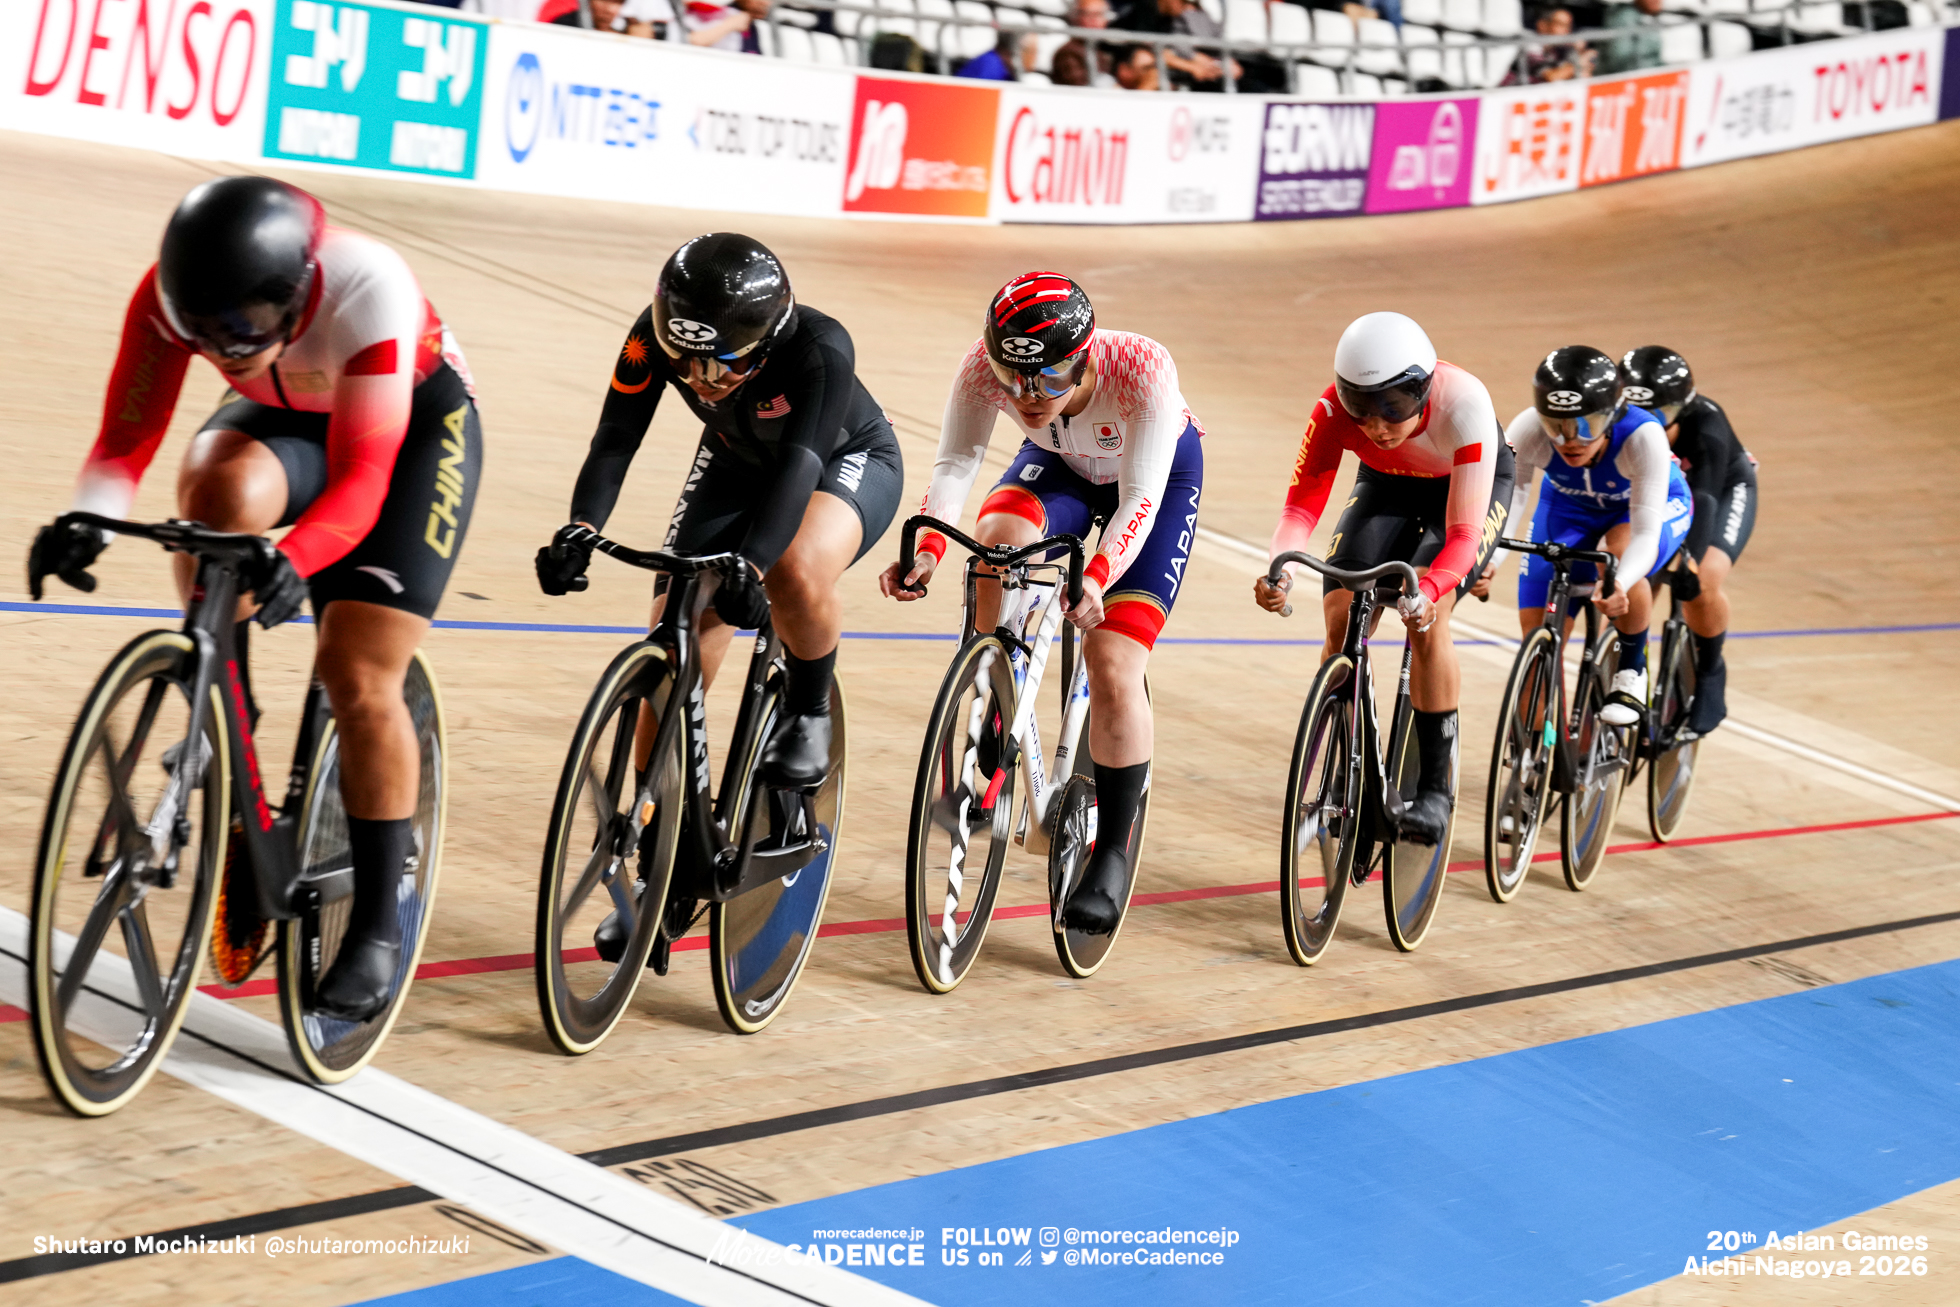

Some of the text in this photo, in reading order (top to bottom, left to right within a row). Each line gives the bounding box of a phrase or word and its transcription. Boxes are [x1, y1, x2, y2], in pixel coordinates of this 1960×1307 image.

[24, 0, 256, 127] DENSO
[1814, 50, 1929, 124] TOYOTA
[1004, 106, 1129, 206] Canon
[667, 333, 716, 351] Kabuto
[1002, 353, 1044, 363] Kabuto
[424, 404, 469, 560] CHINA
[1289, 417, 1317, 488] CHINA
[662, 444, 715, 553] MALAYSI
[1116, 497, 1153, 557] JAPAN
[1475, 499, 1508, 567] CHINA
[1162, 485, 1201, 600] JAPAN
